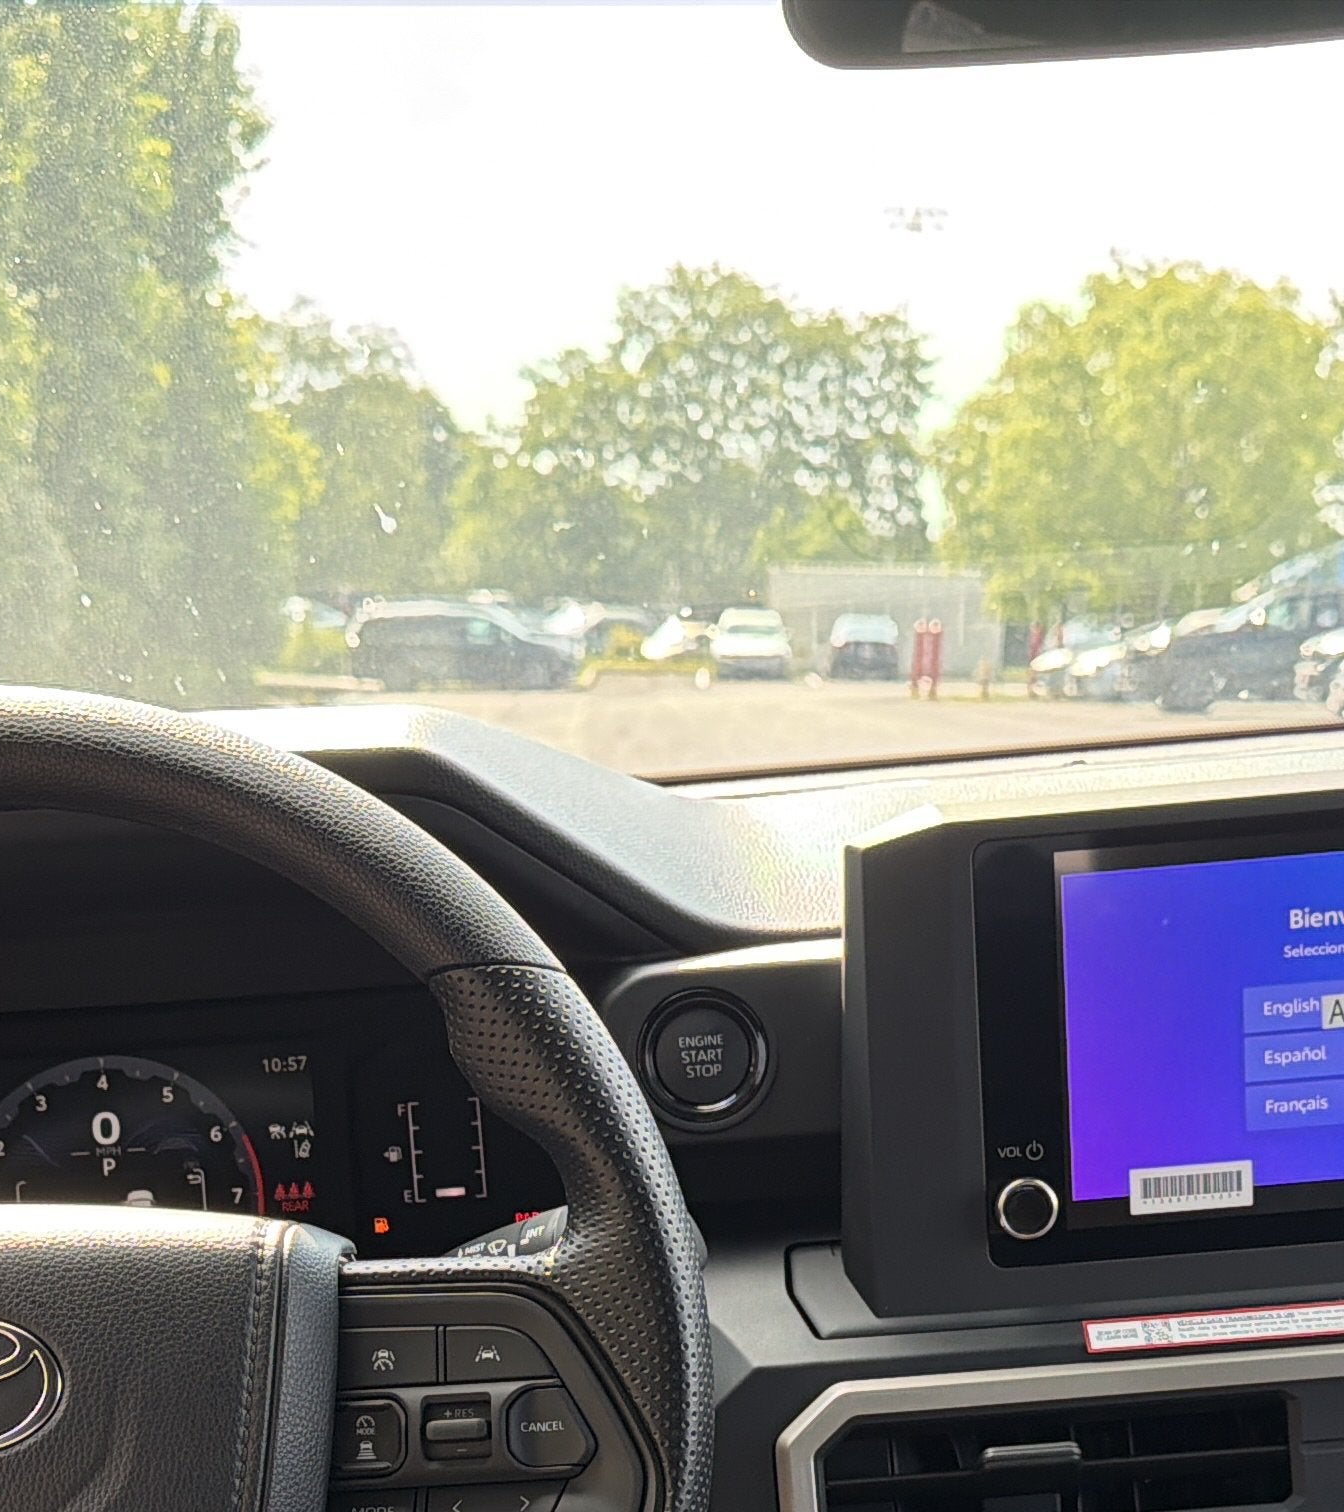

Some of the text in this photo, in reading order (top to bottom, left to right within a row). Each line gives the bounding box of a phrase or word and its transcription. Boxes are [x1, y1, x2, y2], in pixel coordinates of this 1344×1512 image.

[1263, 997, 1320, 1018] English
[678, 1034, 724, 1049] ENGINE
[262, 1055, 308, 1073] 10:57
[681, 1048, 724, 1064] START
[1264, 1045, 1327, 1066] Español
[686, 1063, 723, 1079] STOP
[96, 1074, 109, 1091] 4
[35, 1094, 48, 1112] 3
[161, 1086, 174, 1103] 5
[1265, 1094, 1329, 1114] Français
[91, 1111, 121, 1146] 0
[209, 1125, 223, 1142] 6
[997, 1146, 1023, 1159] VOL
[102, 1157, 116, 1177] P
[231, 1187, 244, 1204] 7
[282, 1200, 309, 1212] REAR
[356, 1427, 375, 1436] MODE
[520, 1420, 565, 1433] CANCEL
